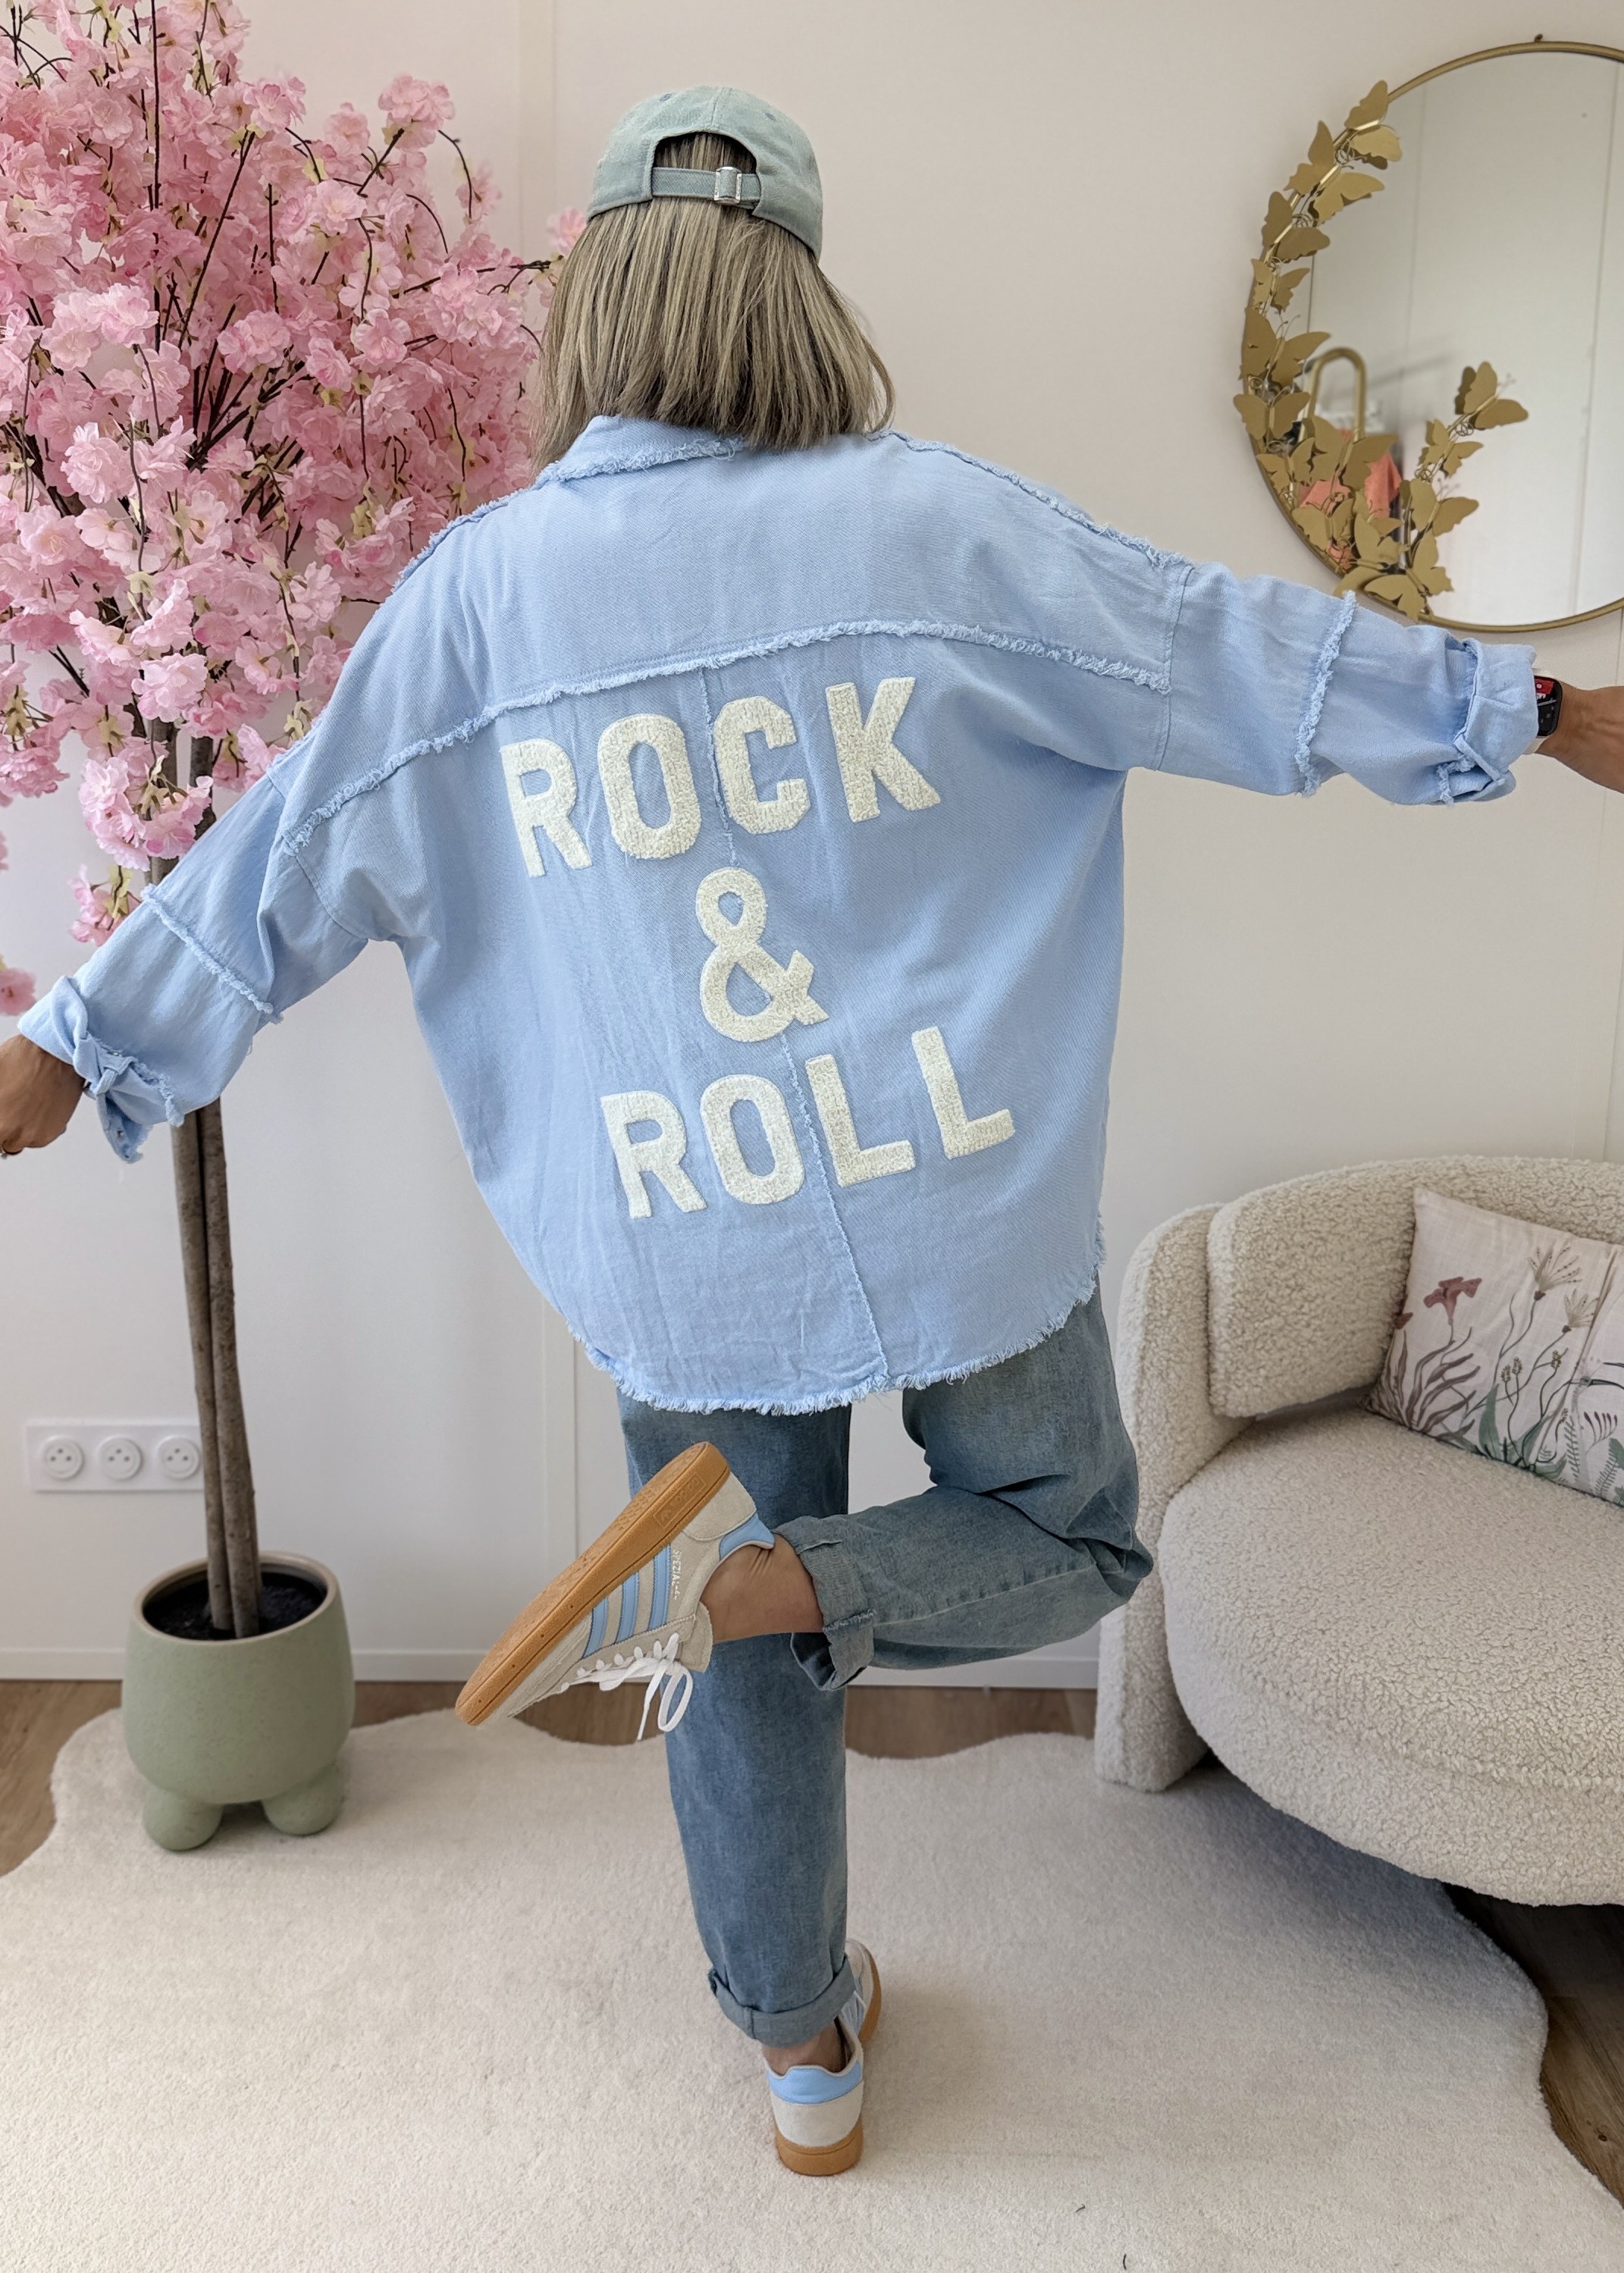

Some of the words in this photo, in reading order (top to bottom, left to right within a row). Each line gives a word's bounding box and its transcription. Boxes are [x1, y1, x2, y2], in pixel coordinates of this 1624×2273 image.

[500, 677, 941, 878] ROCK
[695, 867, 829, 1042] &
[600, 1026, 1015, 1219] ROLL
